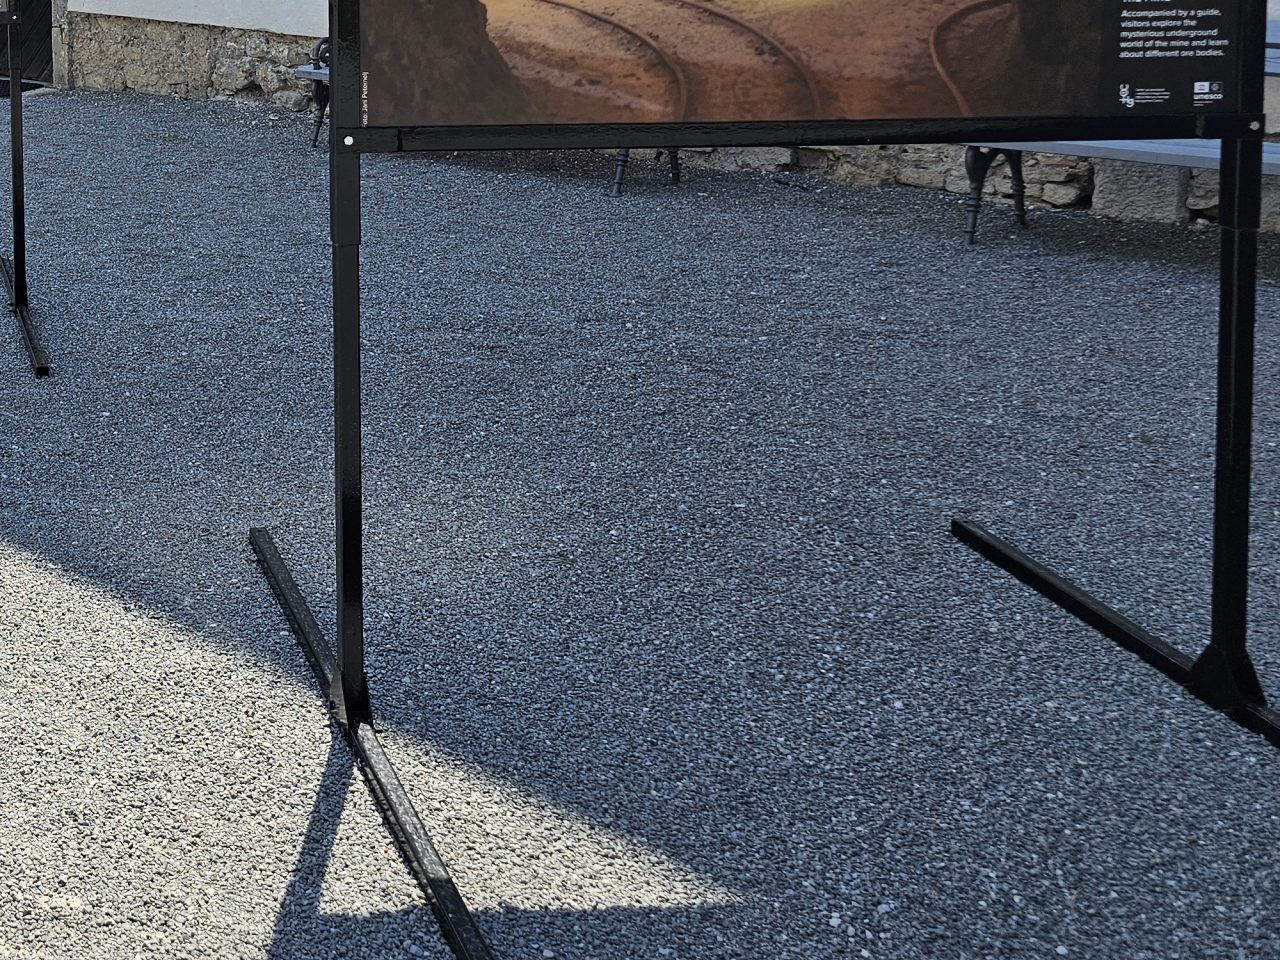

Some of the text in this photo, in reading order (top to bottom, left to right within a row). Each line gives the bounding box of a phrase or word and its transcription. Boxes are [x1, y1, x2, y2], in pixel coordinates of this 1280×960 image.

[1121, 9, 1176, 18] Accompanied
[1178, 9, 1188, 17] by
[1151, 20, 1182, 28] explore
[1120, 29, 1218, 39] mysterious underground
